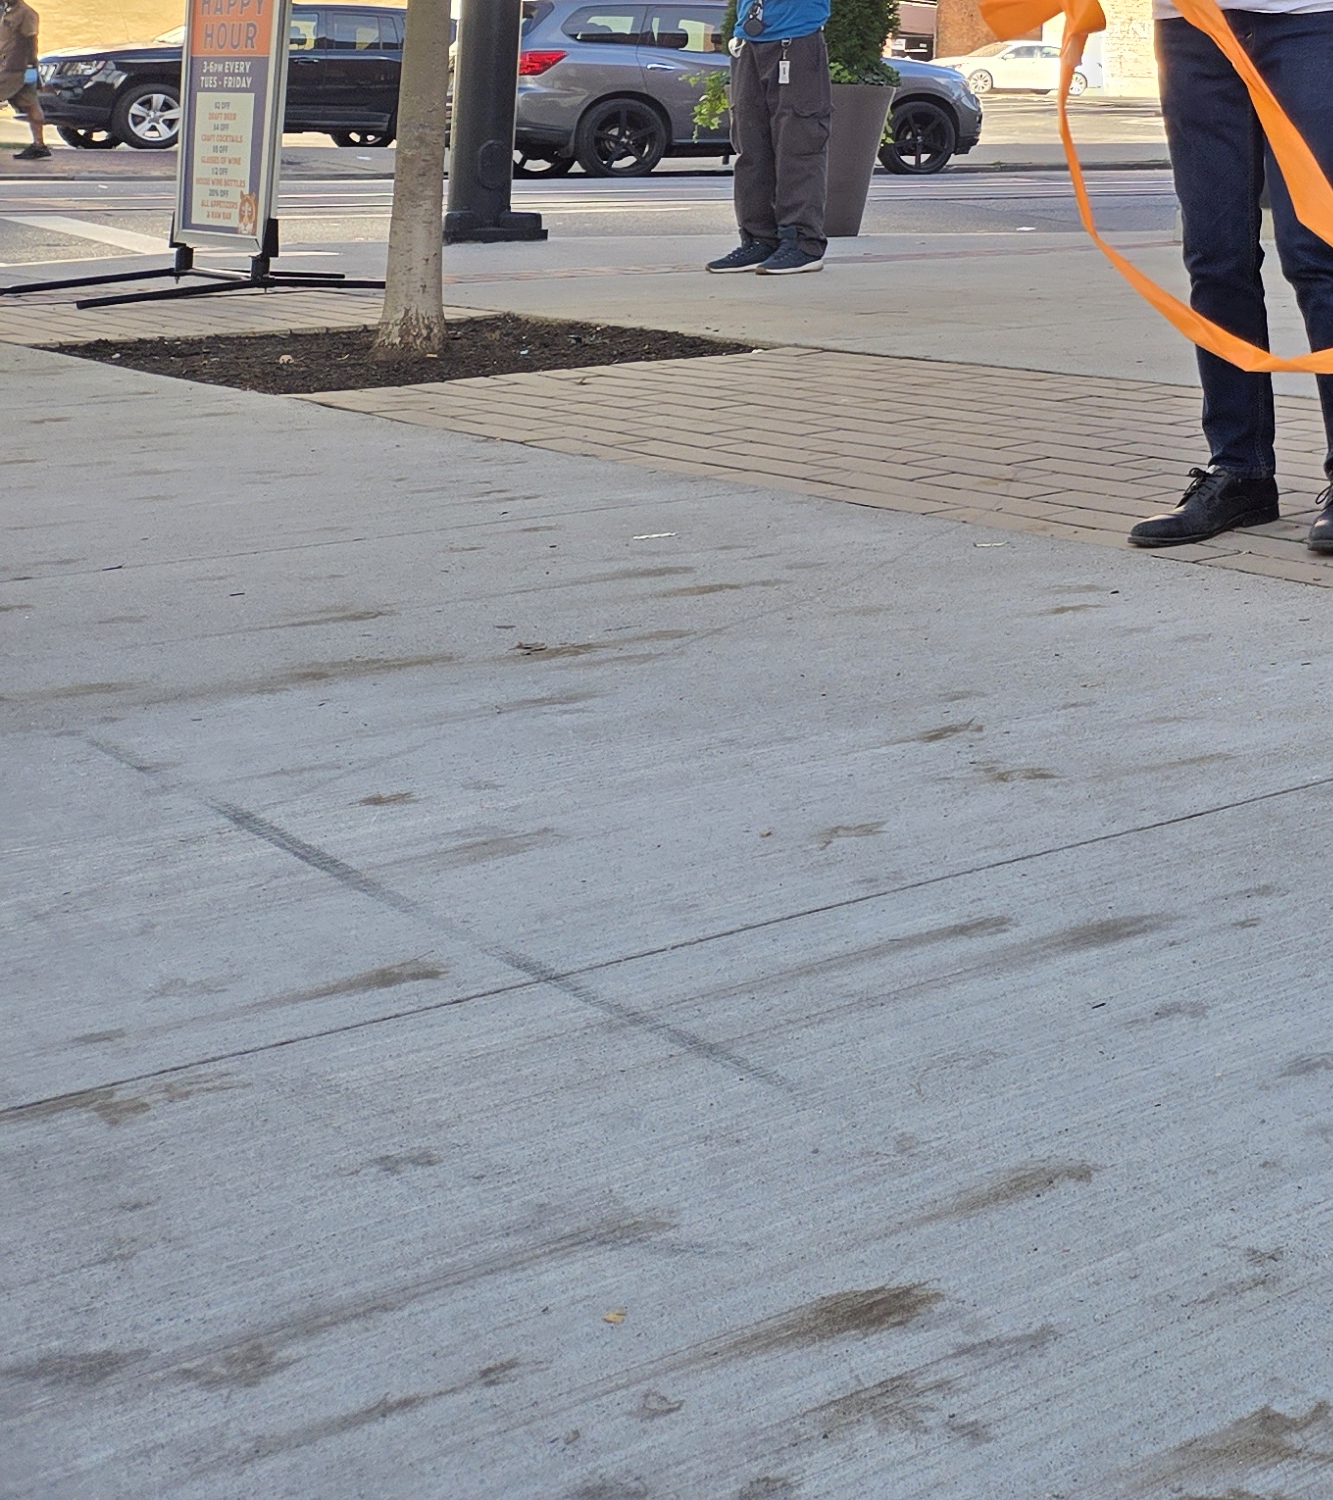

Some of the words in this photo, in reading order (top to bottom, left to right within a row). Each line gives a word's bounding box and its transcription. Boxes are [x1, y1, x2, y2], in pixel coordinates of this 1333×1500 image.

[203, 22, 258, 50] HOUR
[224, 61, 252, 74] EVERY
[200, 76, 218, 88] TUES
[223, 76, 253, 89] FRIDAY
[220, 123, 230, 132] OFF
[219, 145, 229, 154] OFF
